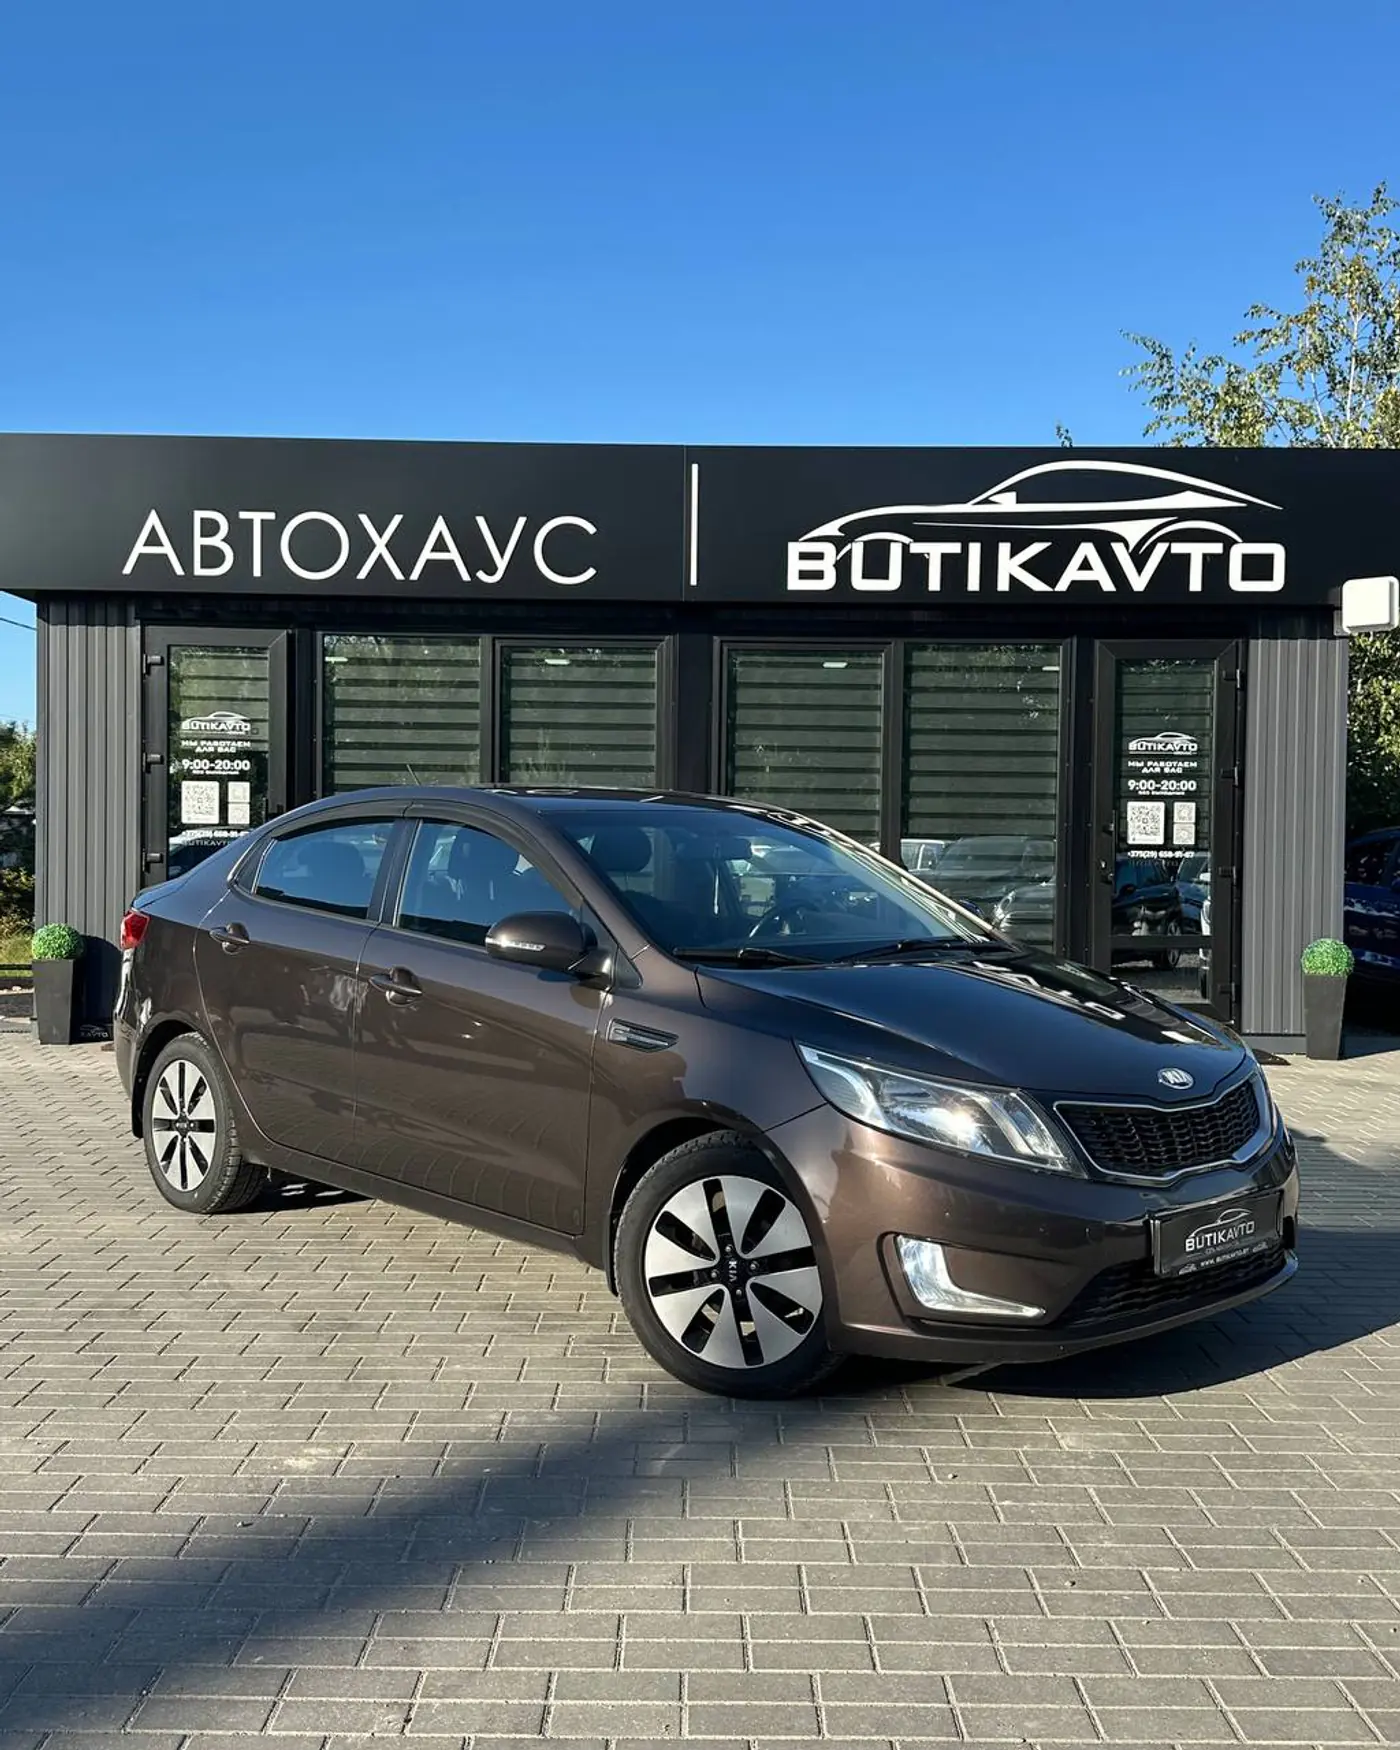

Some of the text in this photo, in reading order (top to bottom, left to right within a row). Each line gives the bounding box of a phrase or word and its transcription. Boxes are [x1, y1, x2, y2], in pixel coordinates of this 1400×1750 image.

[122, 508, 598, 585] АВТОХАУС
[787, 541, 1286, 592] BUTIKAVTO
[1128, 741, 1198, 751] BUTIKAVTO
[182, 759, 251, 771] 9:00-20:00
[1127, 779, 1197, 791] 9:00-20:00
[1185, 1221, 1255, 1252] BUTIKAVTO
[728, 1260, 738, 1282] KIA
